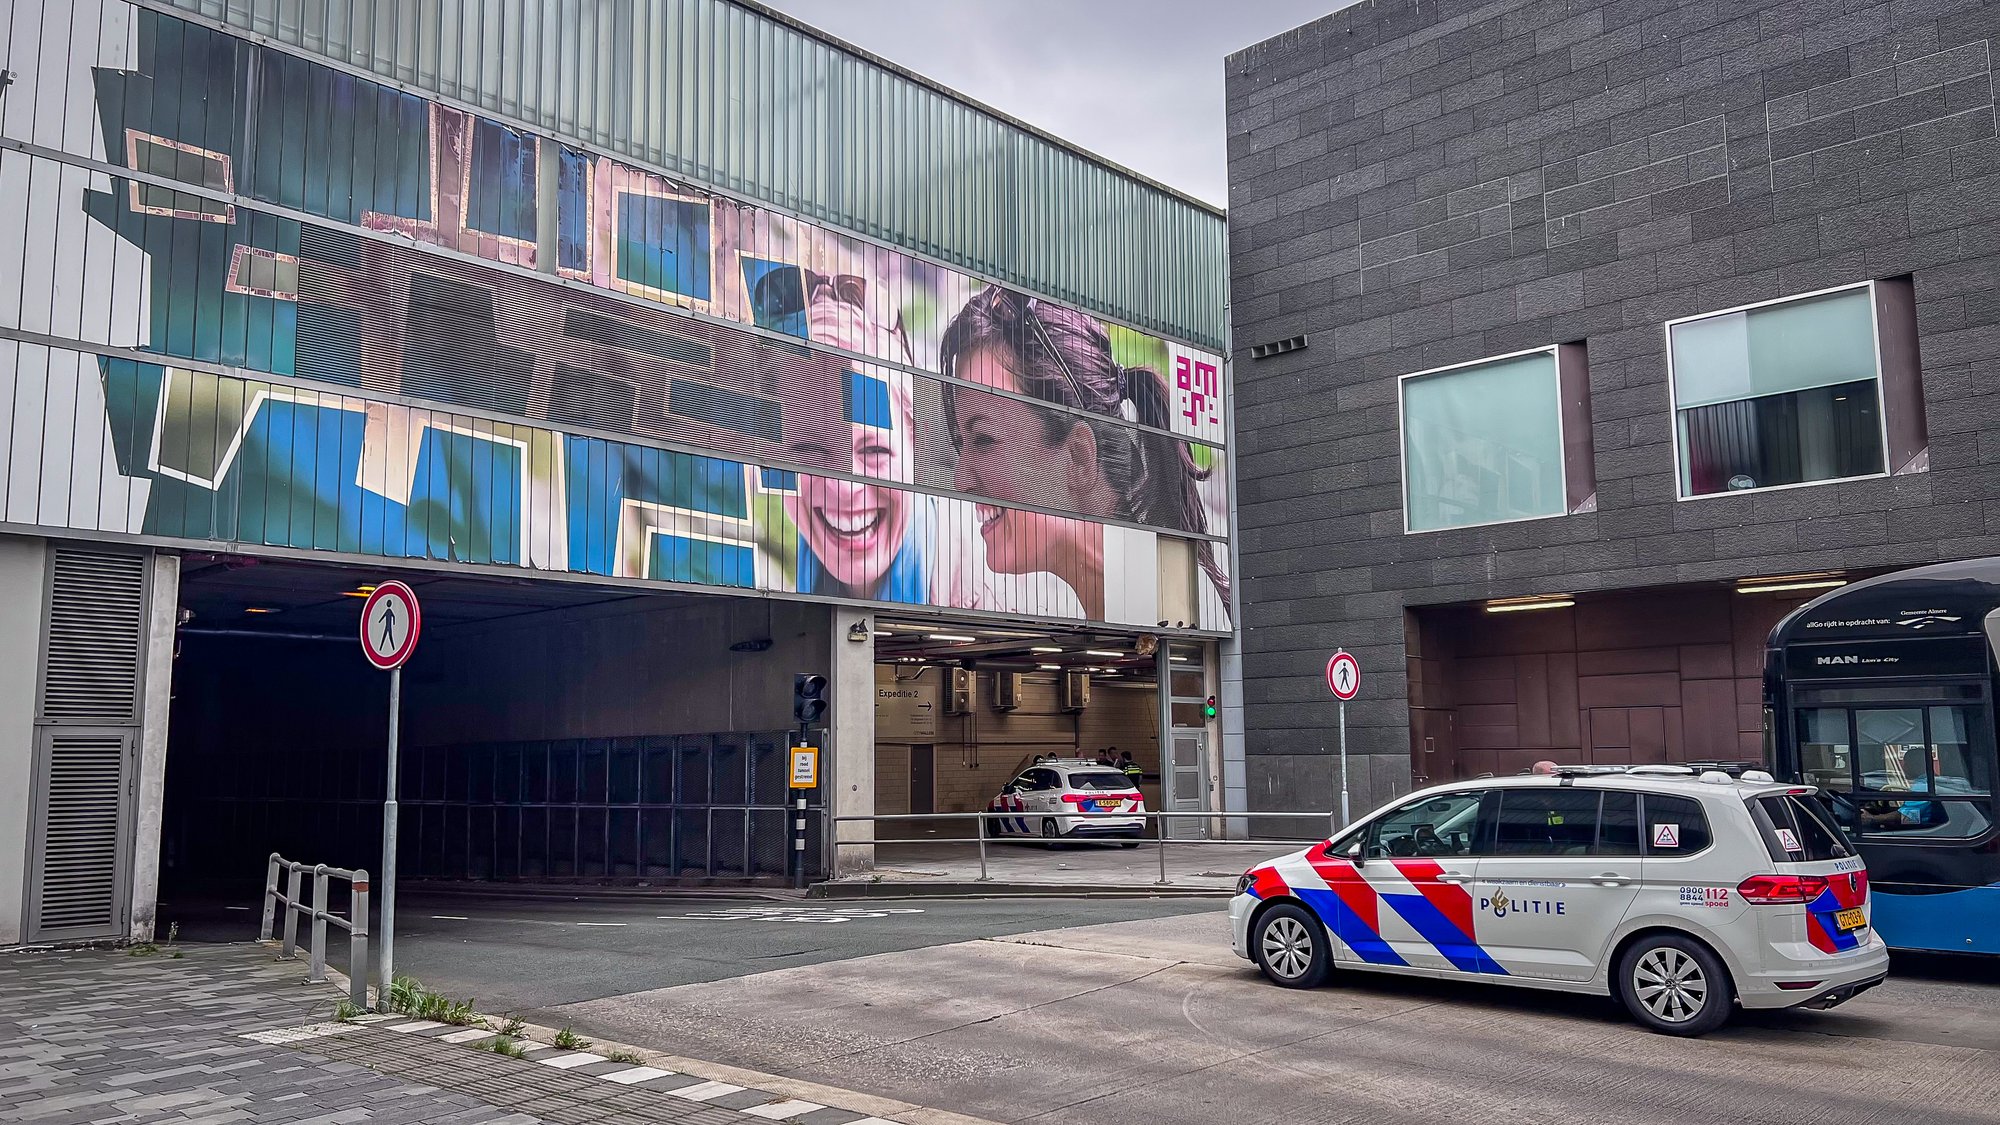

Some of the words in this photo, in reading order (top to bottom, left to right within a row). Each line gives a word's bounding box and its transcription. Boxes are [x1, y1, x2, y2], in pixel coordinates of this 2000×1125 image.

[1824, 620, 1837, 628] rijdt
[1845, 618, 1875, 627] opdracht
[1817, 655, 1858, 665] MAN
[879, 689, 912, 698] Expeditie
[914, 690, 919, 698] 2
[1834, 860, 1857, 871] POLITIE
[1680, 886, 1703, 894] 0900
[1705, 888, 1728, 900] 112
[1480, 897, 1565, 917] POLITIE
